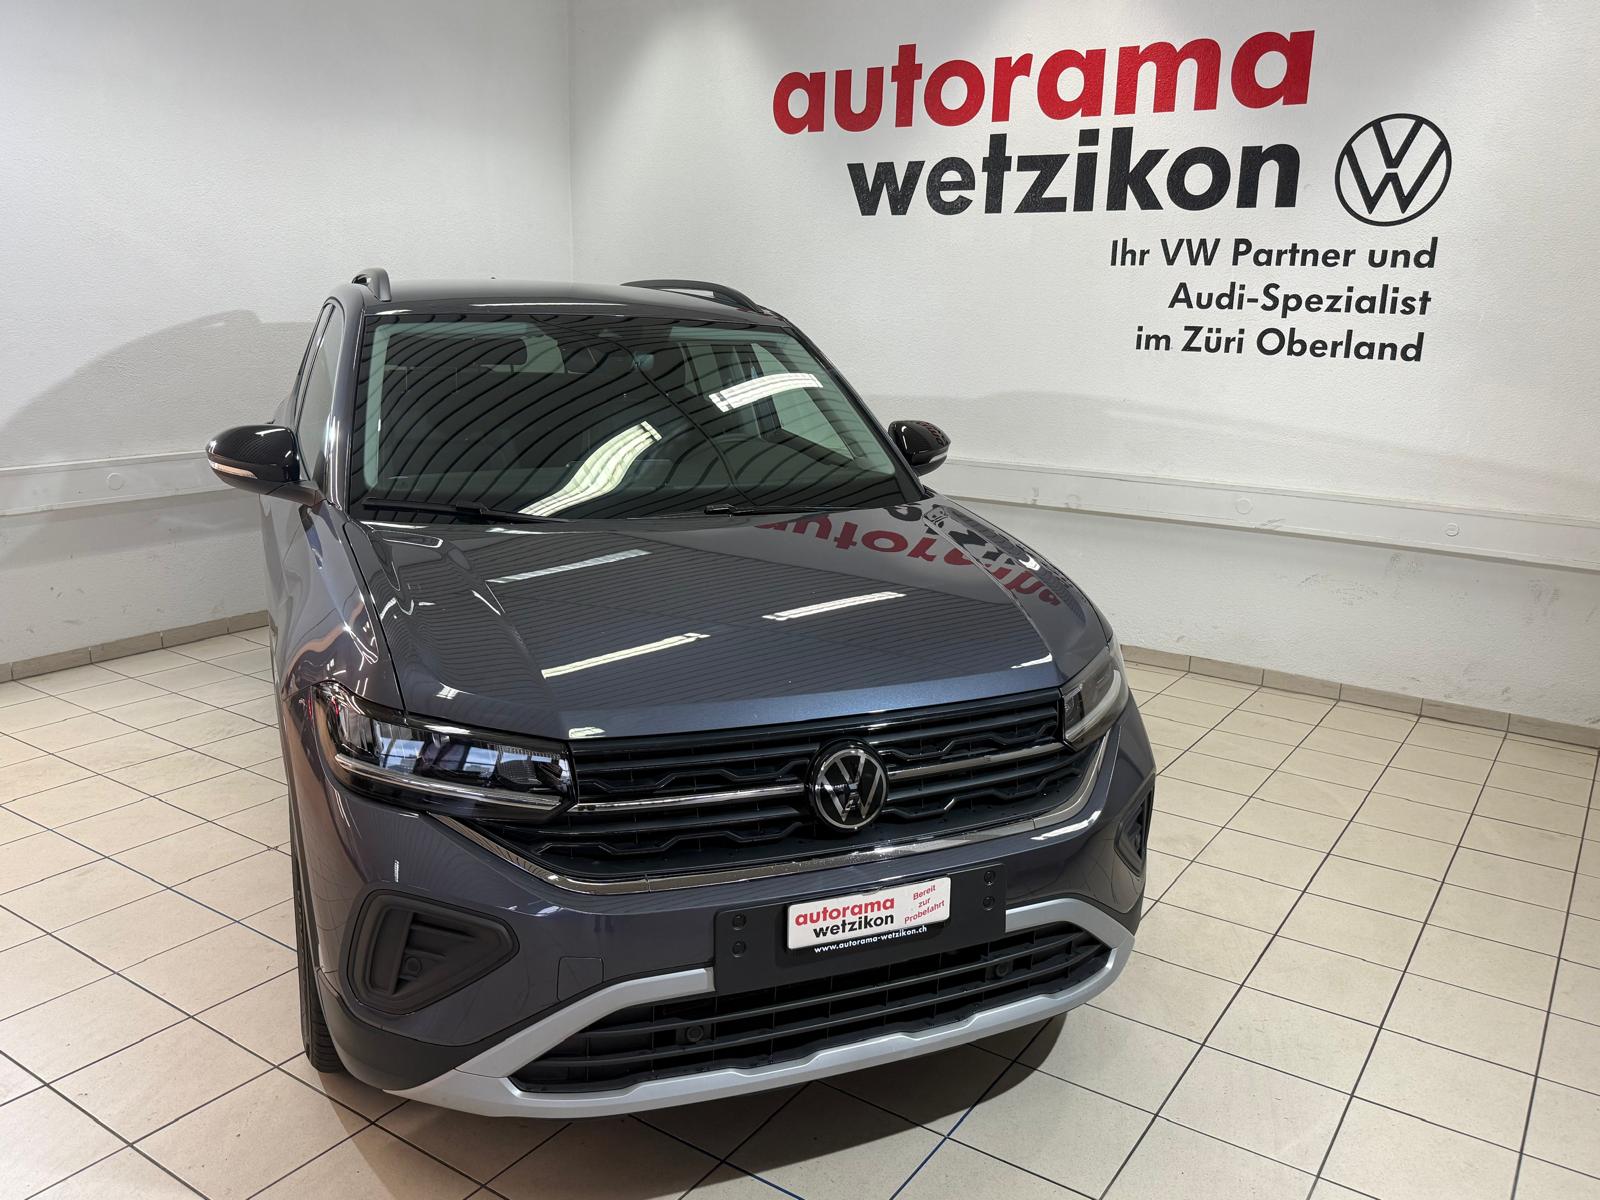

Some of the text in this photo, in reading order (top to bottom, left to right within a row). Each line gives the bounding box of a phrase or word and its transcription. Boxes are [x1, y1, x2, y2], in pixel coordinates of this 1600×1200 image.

[773, 31, 1315, 134] autorama
[847, 127, 1301, 216] wetzikon
[1110, 237, 1438, 269] Ihr VW Partner und
[1167, 281, 1432, 318] Audi-Spezialist
[1135, 325, 1425, 362] im Züri Oberland
[912, 884, 936, 901] Bereit
[918, 897, 931, 908] zur
[795, 898, 895, 926] autorama
[813, 914, 894, 938] wetzikon
[904, 900, 945, 924] Probefahrt
[814, 925, 927, 953] www.autorama-wetzikon.ch
